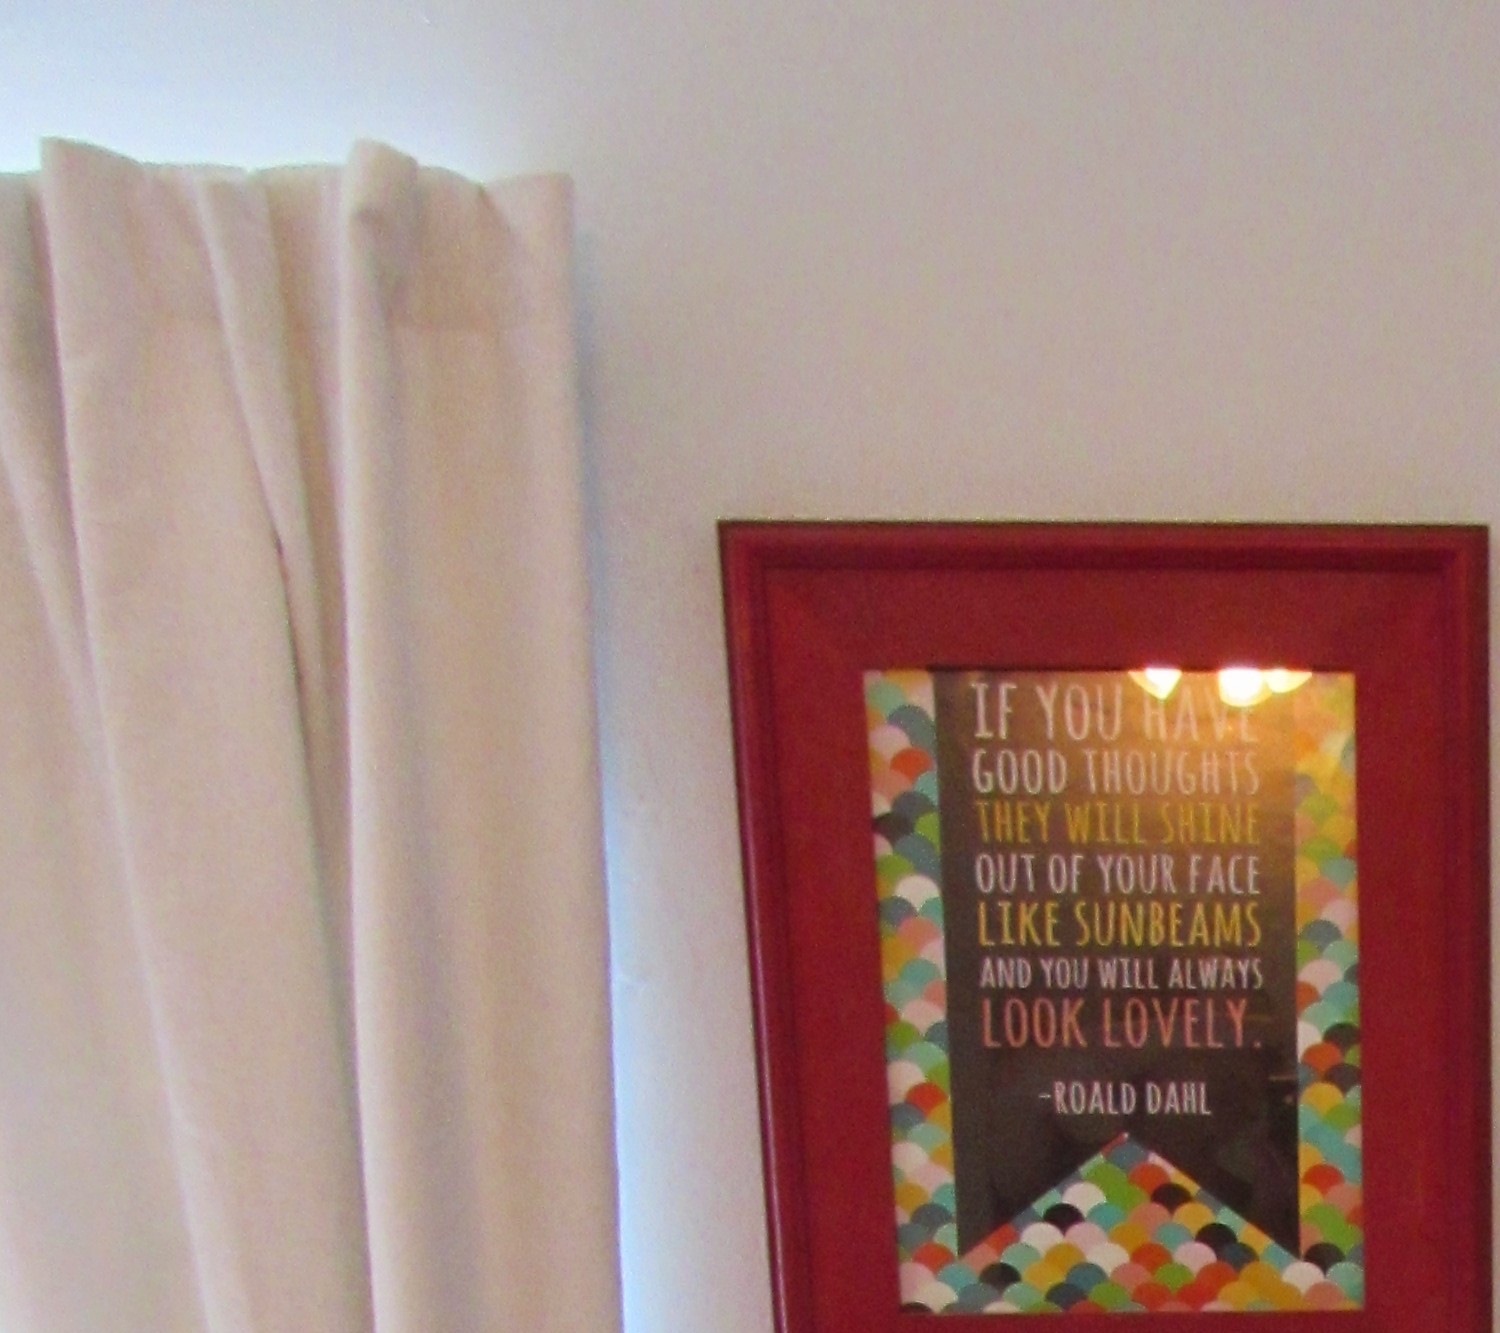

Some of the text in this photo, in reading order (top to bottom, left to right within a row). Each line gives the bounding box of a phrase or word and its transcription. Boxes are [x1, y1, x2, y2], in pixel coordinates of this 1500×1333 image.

[969, 682, 1018, 740] IF
[1036, 682, 1123, 741] YOU
[971, 748, 1261, 796] GOOD THOUGHTS
[976, 801, 1261, 845] THEY WILL SHINE
[974, 854, 1261, 895] OUT OF YOUR FACE
[977, 902, 1263, 948] LIKE SUNBEAMS
[979, 958, 1264, 990] AND YOU WILL ALWAYS
[981, 999, 1262, 1051] LOOK LOVELY.
[1145, 1081, 1212, 1116] DAHL
